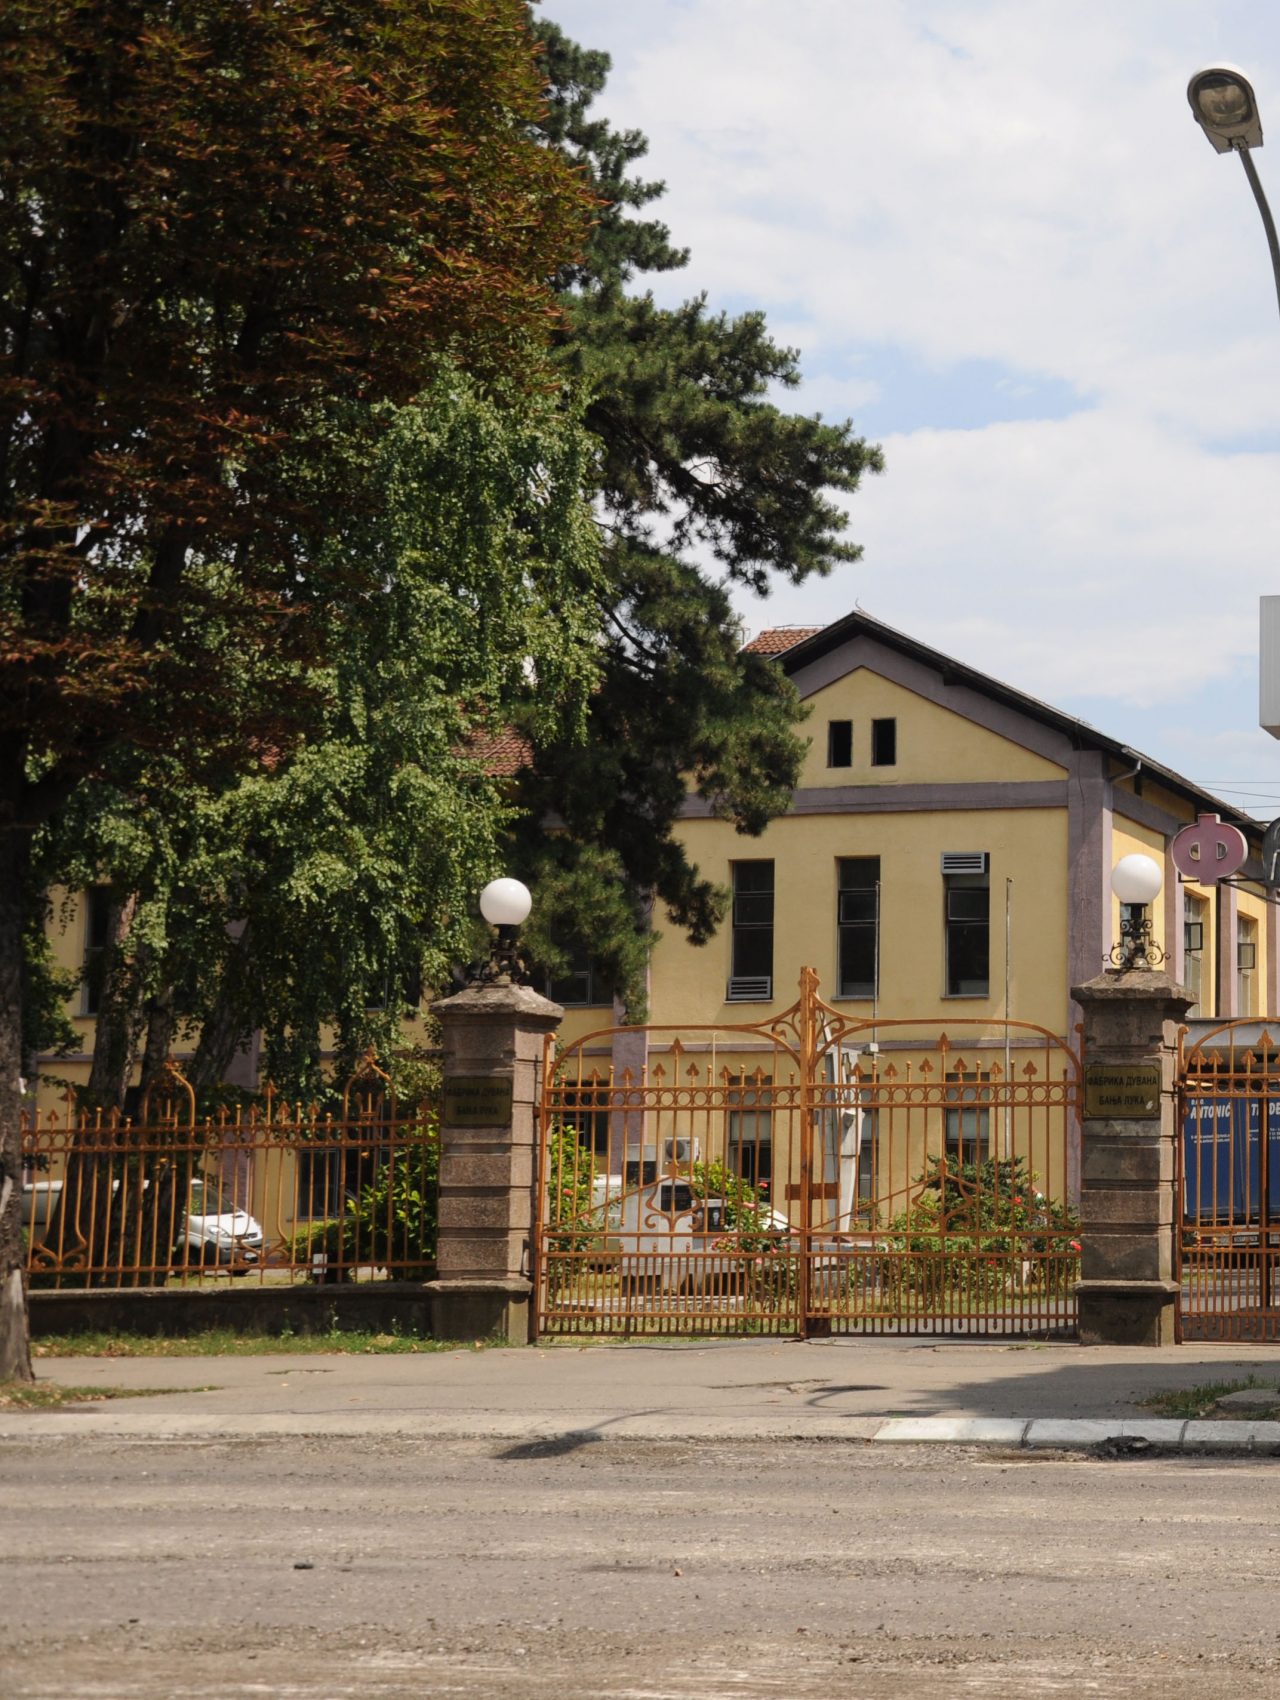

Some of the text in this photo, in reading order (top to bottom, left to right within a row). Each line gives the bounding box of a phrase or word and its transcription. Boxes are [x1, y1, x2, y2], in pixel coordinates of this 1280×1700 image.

[1088, 1076, 1157, 1087] ФАБРИКА ДУВАНА
[1124, 1095, 1145, 1105] ЛУКА
